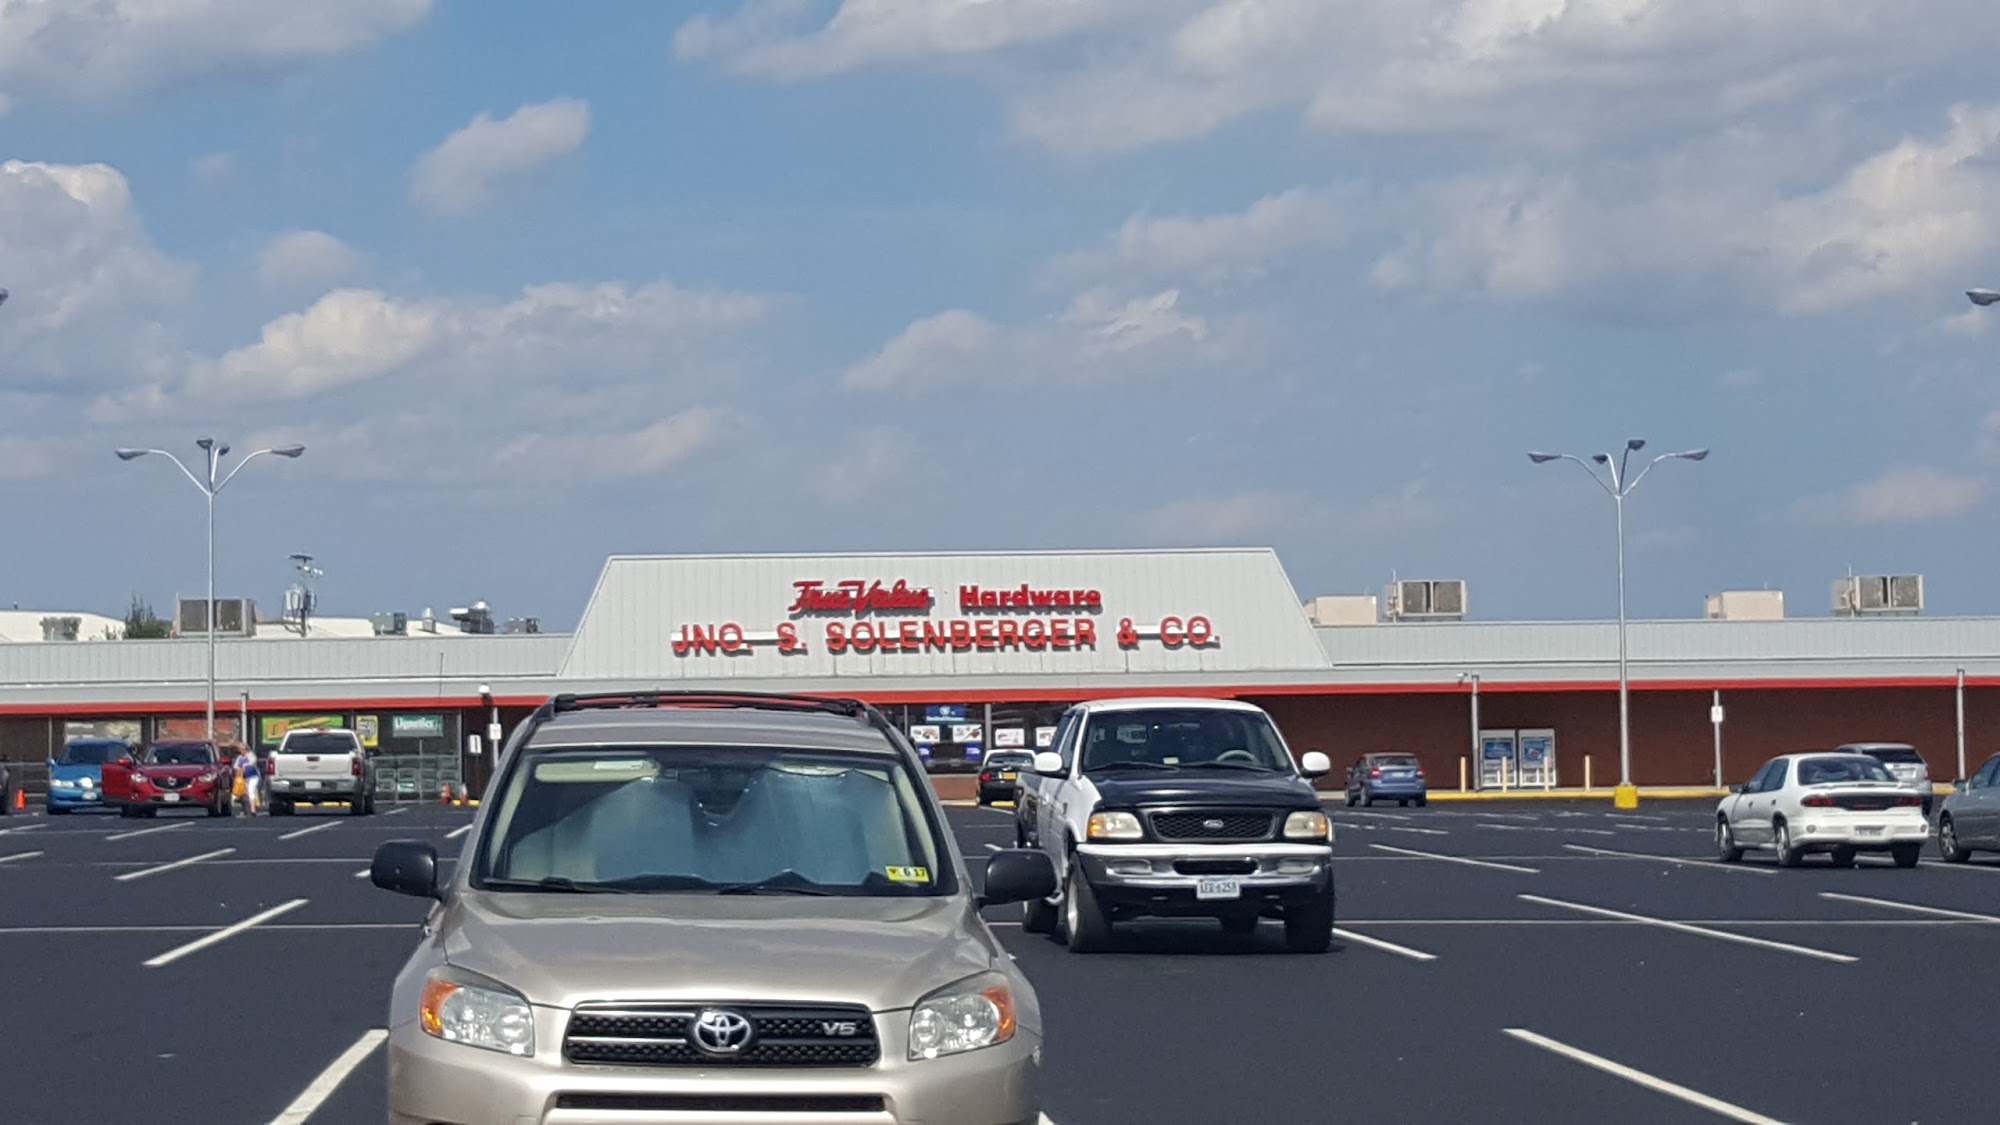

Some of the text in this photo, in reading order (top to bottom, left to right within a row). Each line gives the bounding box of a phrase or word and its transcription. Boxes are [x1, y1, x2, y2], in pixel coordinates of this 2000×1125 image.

[788, 578, 1102, 611] True Value Hardware
[671, 616, 1220, 652] JNO. S. SOLENBERGER & CO.
